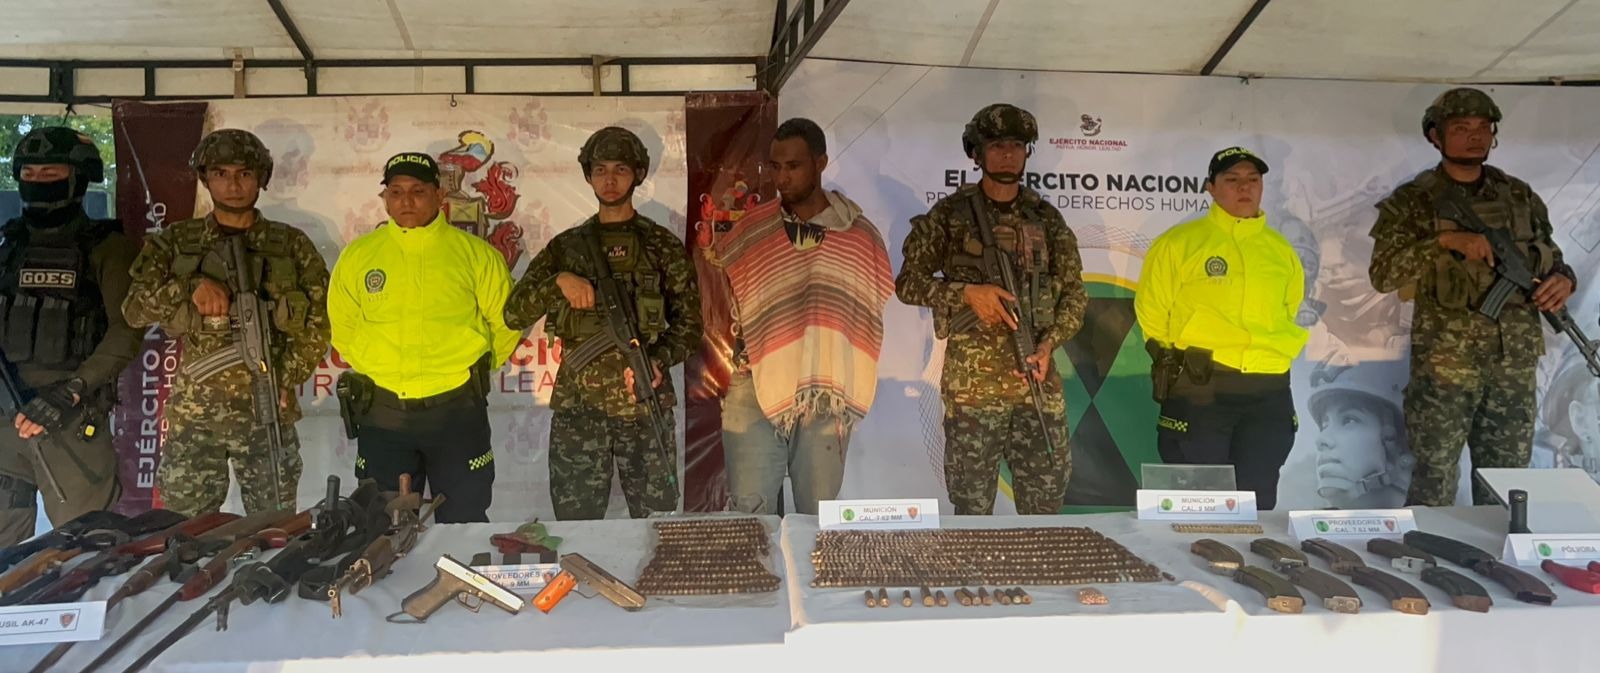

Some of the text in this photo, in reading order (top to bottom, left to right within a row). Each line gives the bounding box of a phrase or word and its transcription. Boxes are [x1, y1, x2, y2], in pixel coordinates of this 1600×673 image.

[1089, 139, 1128, 147] NACIONAL
[1026, 172, 1100, 191] RCITO
[1106, 173, 1212, 194] NACIONA
[1058, 195, 1155, 211] DERECHOS
[1161, 198, 1210, 212] HUMA
[22, 271, 74, 285] GOES
[163, 339, 177, 388] HON
[135, 349, 160, 488] EJÉRCITO
[863, 505, 897, 513] MUNICIÓN
[1560, 544, 1598, 552] PÓLVORA
[486, 571, 540, 581] ROVEEDORES
[0, 618, 49, 628] USIL AK-47
